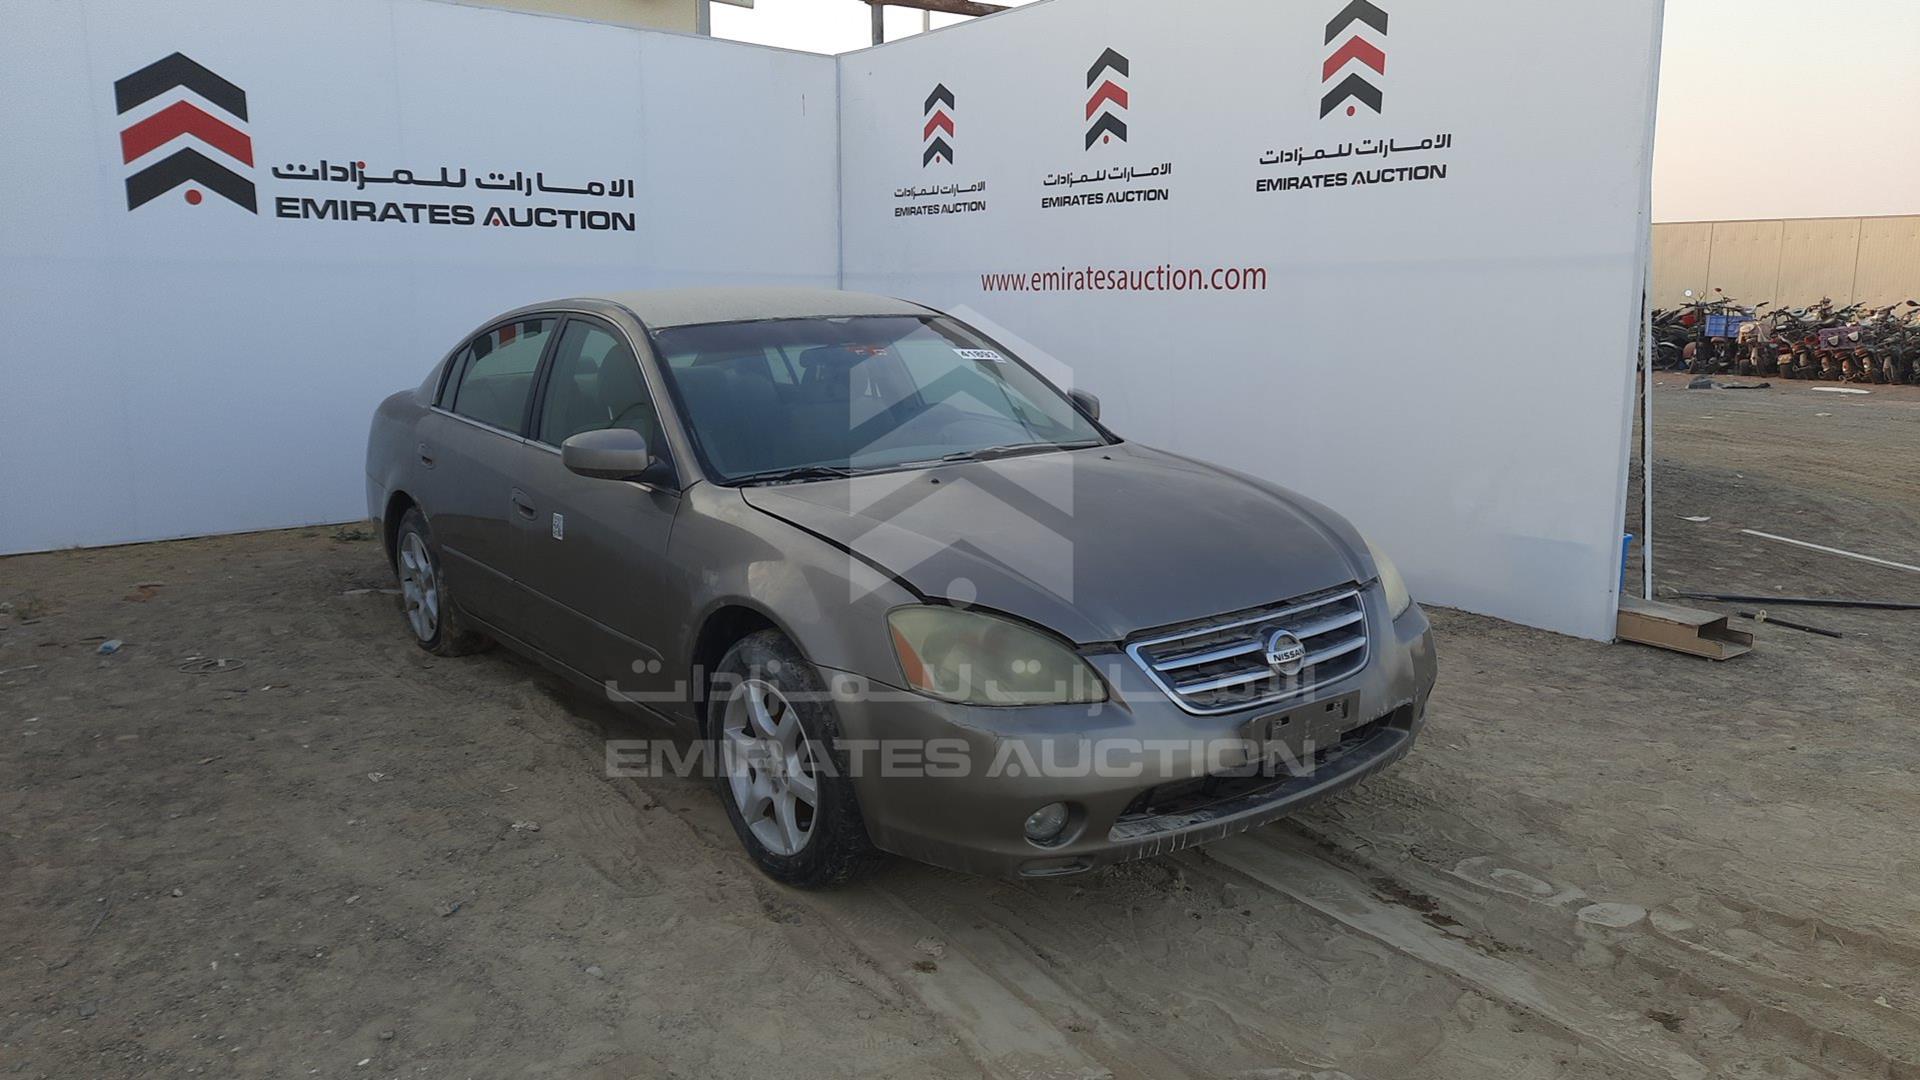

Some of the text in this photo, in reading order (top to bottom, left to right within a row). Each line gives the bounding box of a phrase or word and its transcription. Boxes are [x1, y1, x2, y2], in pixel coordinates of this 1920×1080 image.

[1259, 142, 1352, 165] للمزادات
[271, 159, 467, 190] للمزادات
[1043, 169, 1106, 188] للمزادات
[1255, 164, 1447, 192] EMIRATES AUCTION
[894, 200, 986, 217] EMIRATES AUCTION
[1041, 188, 1169, 208] EMIRATES AUCTION
[275, 196, 636, 231] EMIRATES AUCTION
[981, 264, 1267, 291] www.emiratesauction.com
[1273, 647, 1305, 662] NISSAN
